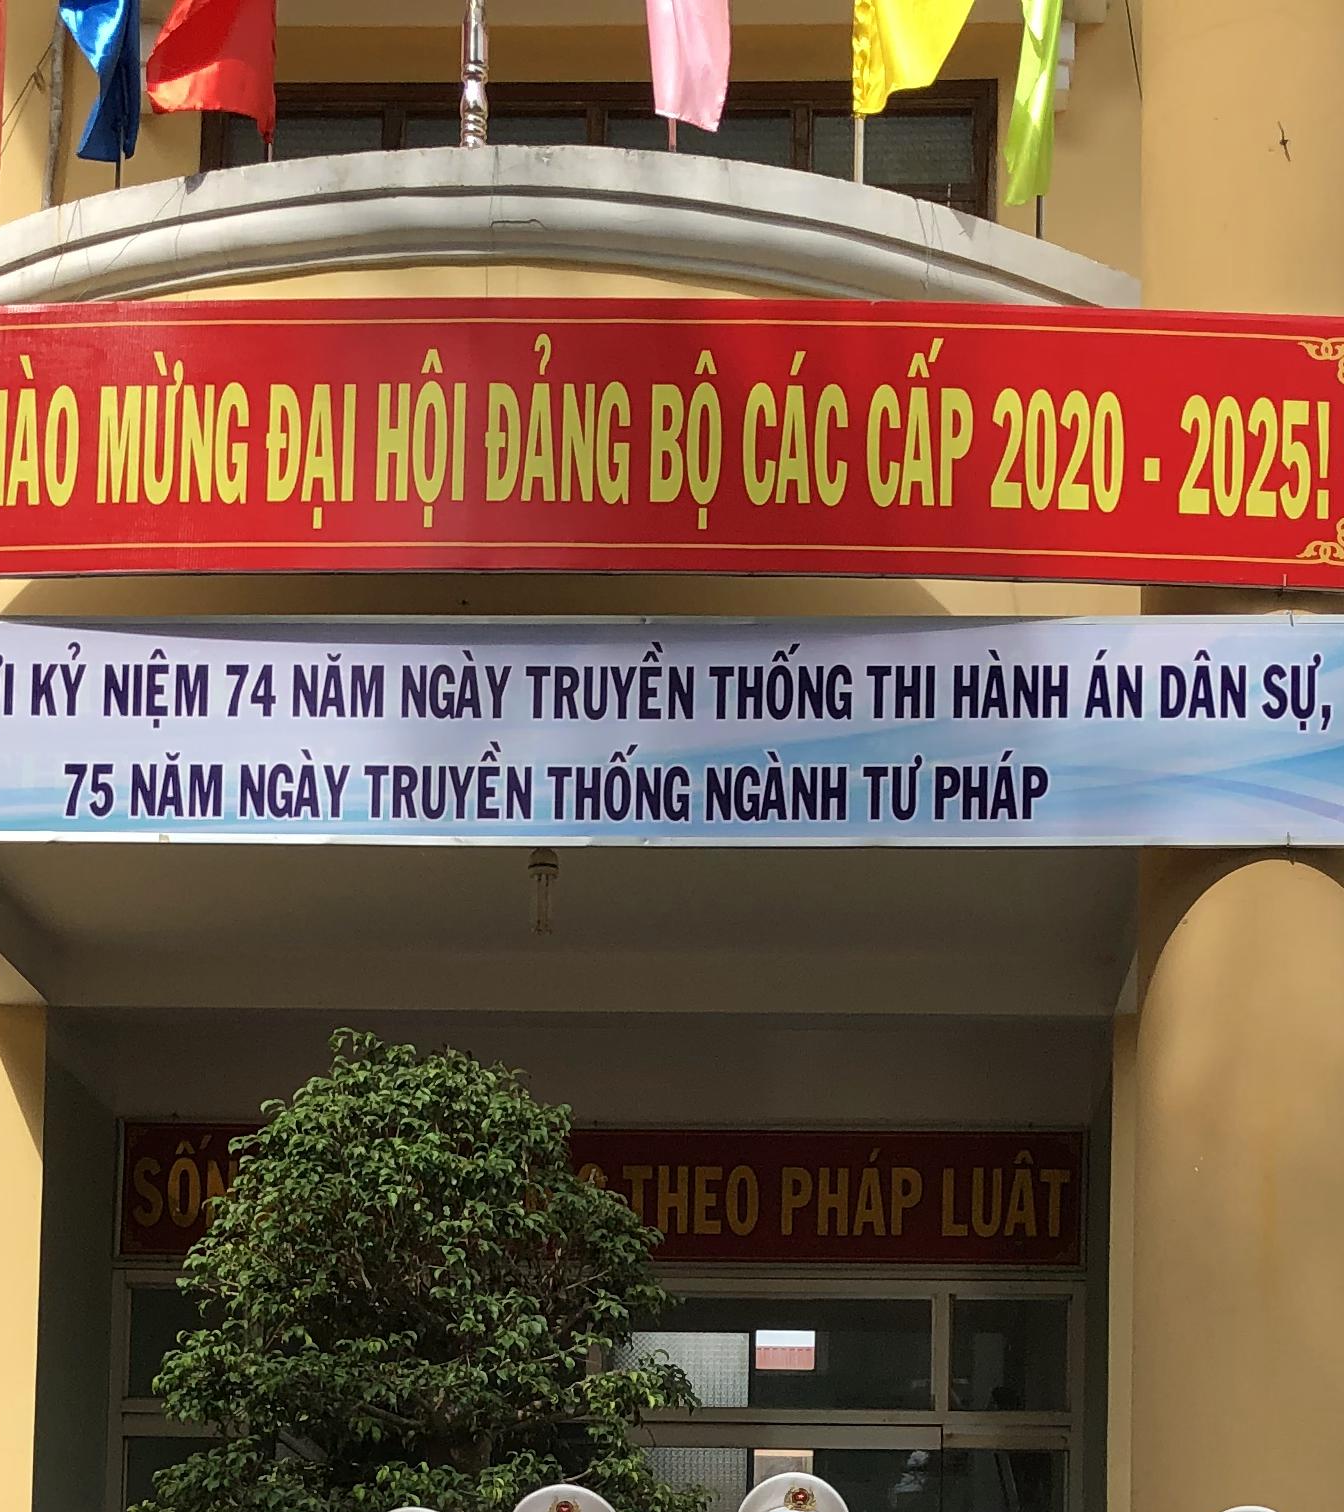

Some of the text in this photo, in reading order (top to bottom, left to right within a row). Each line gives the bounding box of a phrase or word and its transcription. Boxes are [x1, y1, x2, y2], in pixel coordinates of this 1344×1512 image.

[97, 351, 248, 505] MỪNG
[267, 384, 355, 529] ĐẠI
[377, 349, 465, 527] HỘI
[486, 333, 629, 504] ĐẢNG
[651, 350, 721, 530] BỘ
[744, 351, 847, 506] CÁC
[868, 338, 972, 507] CẤP
[991, 389, 1123, 512] 2020
[1180, 396, 1328, 519] 2025!
[31, 641, 86, 716] KỶ
[103, 648, 209, 728] NIỆM
[225, 664, 276, 717] 74
[292, 652, 385, 718] NĂM
[401, 649, 513, 720] NGÀY
[525, 641, 695, 721] TRUYỀN
[708, 643, 853, 721] THỐNG
[866, 665, 936, 719] THI
[952, 649, 1069, 719] HÀNH
[1084, 649, 1143, 719] ÁN
[1160, 649, 1246, 719] DÂN
[1262, 653, 1331, 731] SỰ,
[64, 740, 1049, 822] 75 NĂM NGÀY TRUYỀN THỐNG NGÀNH TƯ PHÁP
[132, 1133, 242, 1229] SỐN
[622, 1164, 760, 1236] THEO
[780, 1146, 924, 1237] PHÁP
